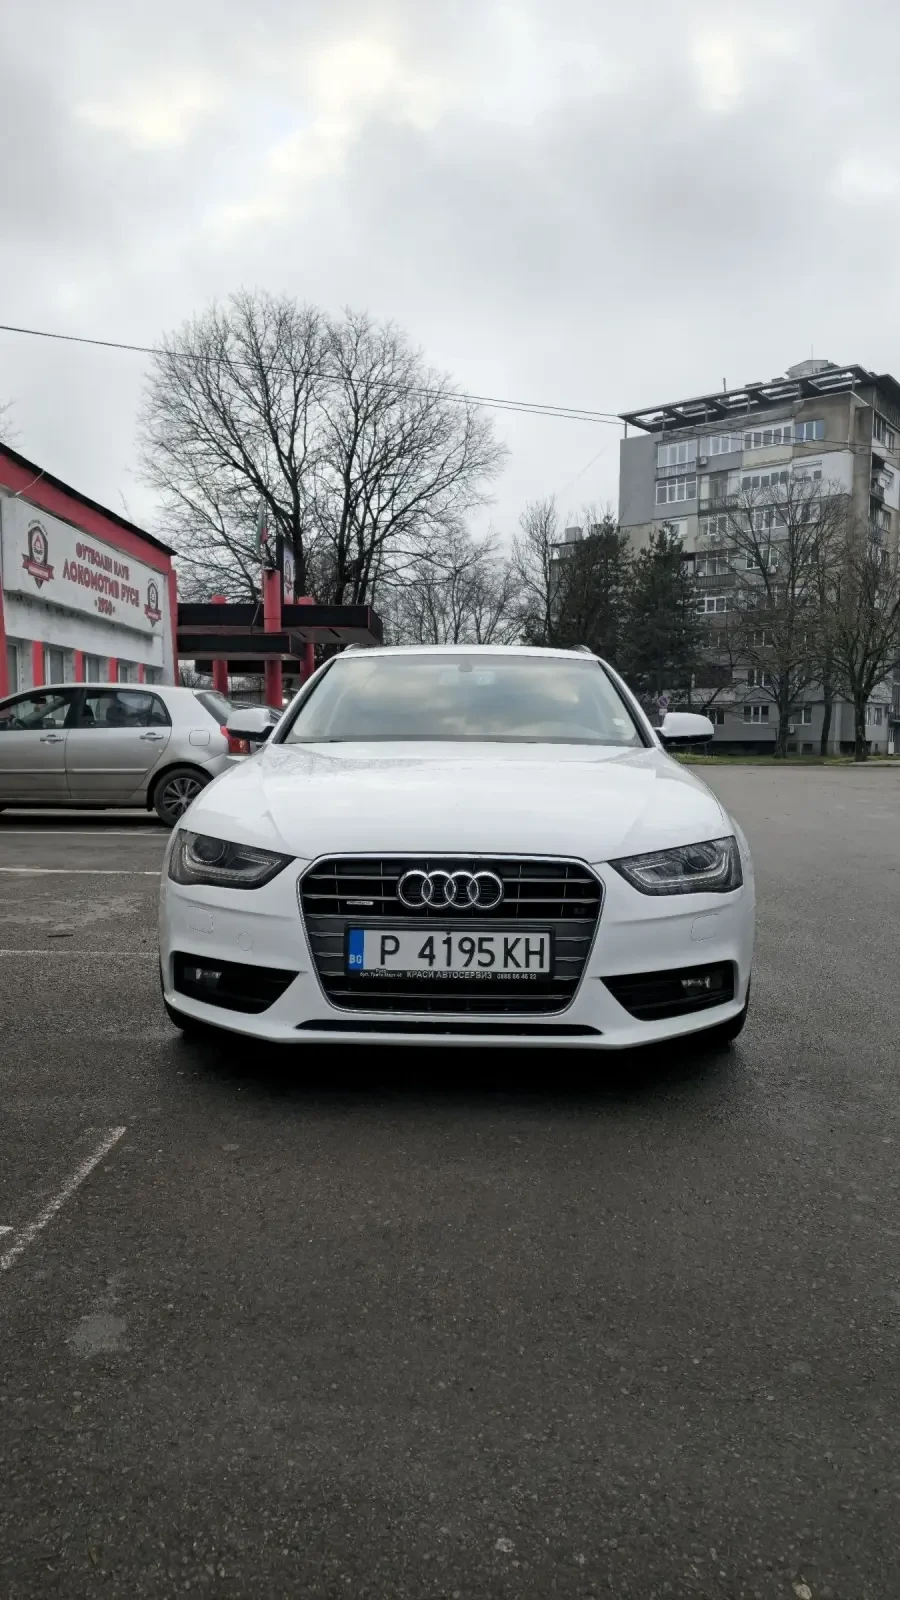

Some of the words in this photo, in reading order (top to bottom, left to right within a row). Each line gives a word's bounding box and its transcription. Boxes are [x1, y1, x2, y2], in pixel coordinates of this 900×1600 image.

[62, 558, 120, 599] ЛОКОМОТИВ
[120, 583, 140, 608] РУСЕ
[348, 954, 362, 964] BG
[435, 971, 492, 979] АВТОСЕРВИЗ
